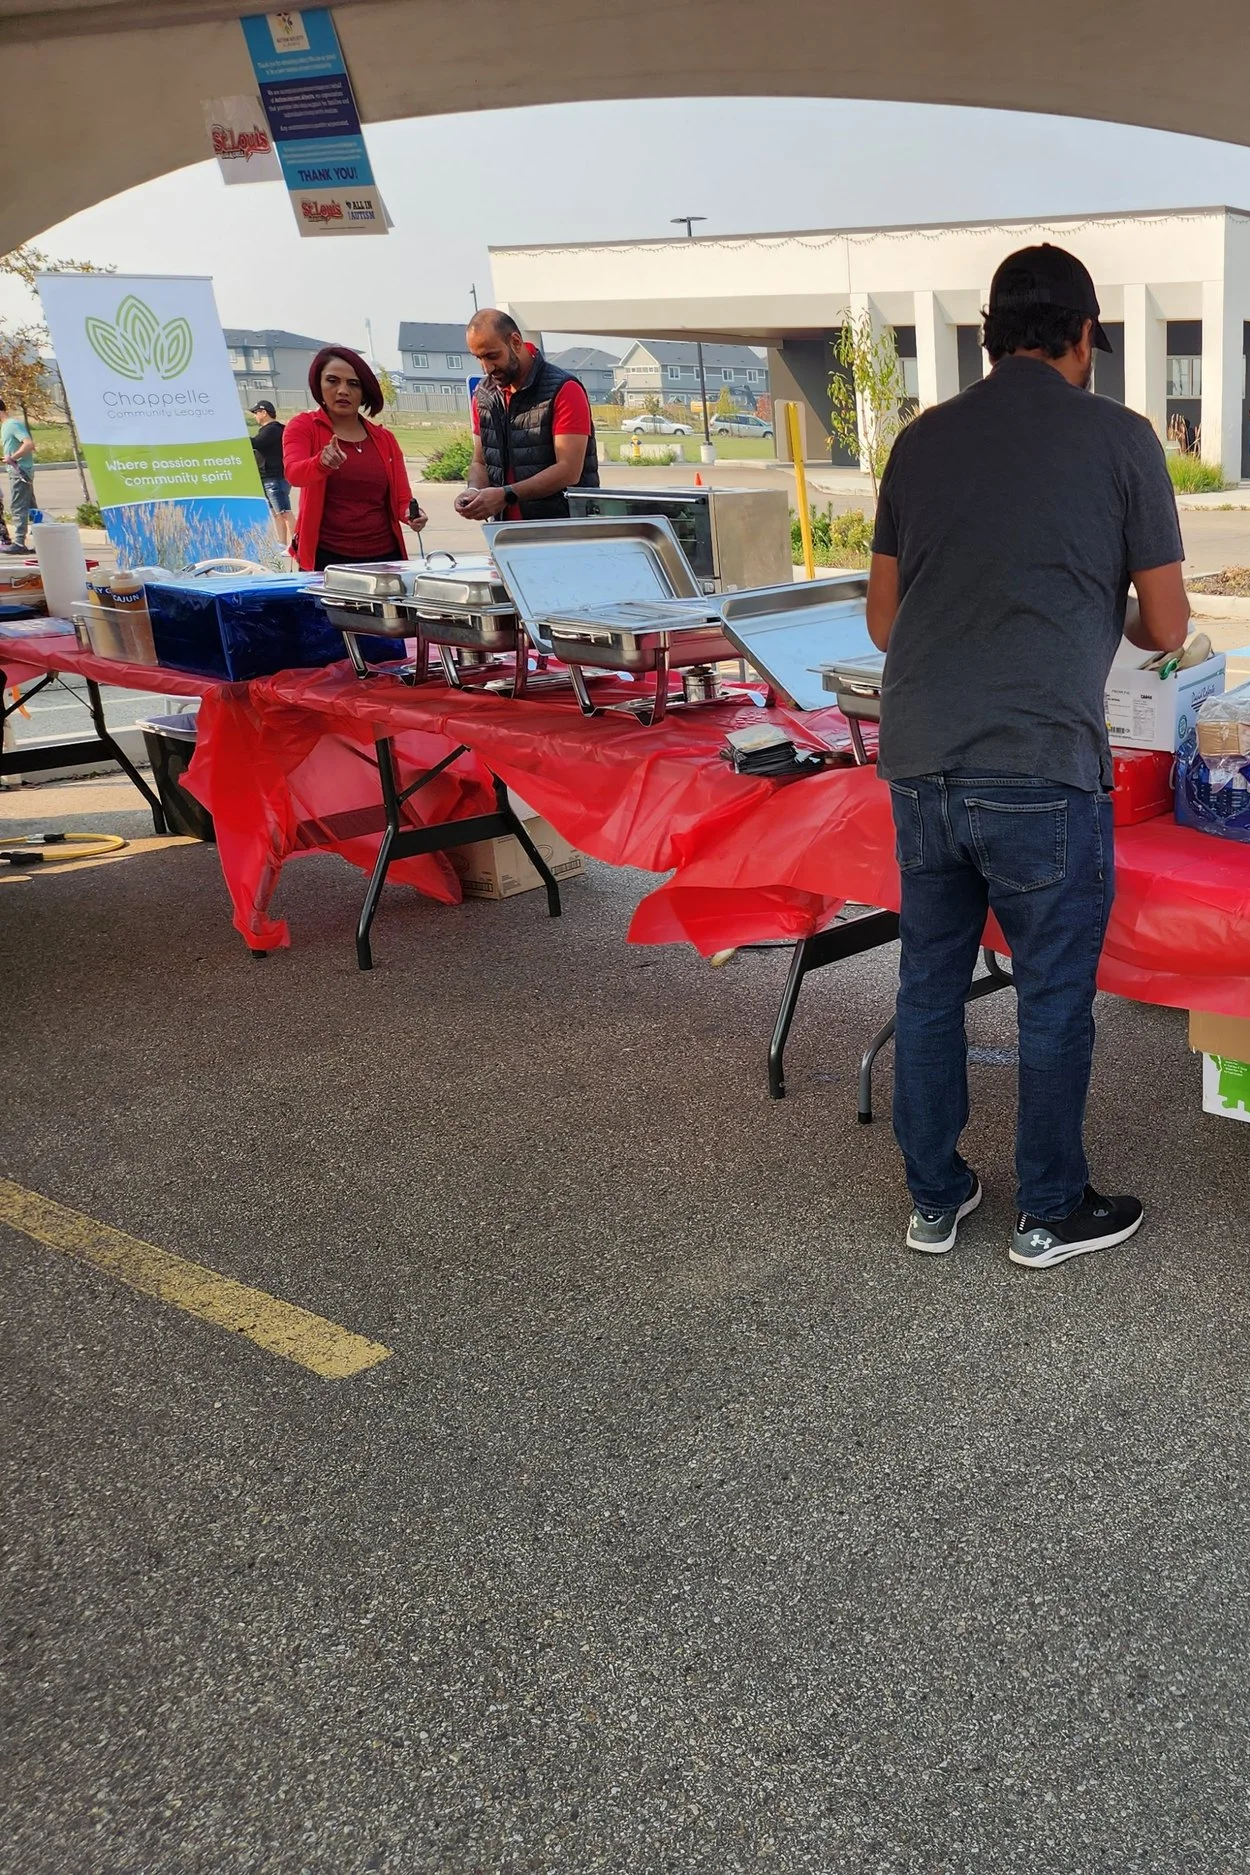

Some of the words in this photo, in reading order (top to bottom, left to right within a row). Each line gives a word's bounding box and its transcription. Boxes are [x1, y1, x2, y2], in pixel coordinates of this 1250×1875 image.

[298, 168, 332, 182] THANK
[332, 167, 358, 180] YOU!
[352, 201, 365, 210] ALL
[351, 210, 376, 220] AUTISM
[102, 390, 211, 408] Chappelle
[107, 409, 172, 419] Community
[174, 407, 216, 418] League
[105, 459, 148, 471] Where
[152, 457, 201, 471] passion
[203, 454, 243, 466] meets
[124, 475, 198, 487] community
[201, 470, 233, 484] spirit
[112, 594, 140, 603] CAJUN
